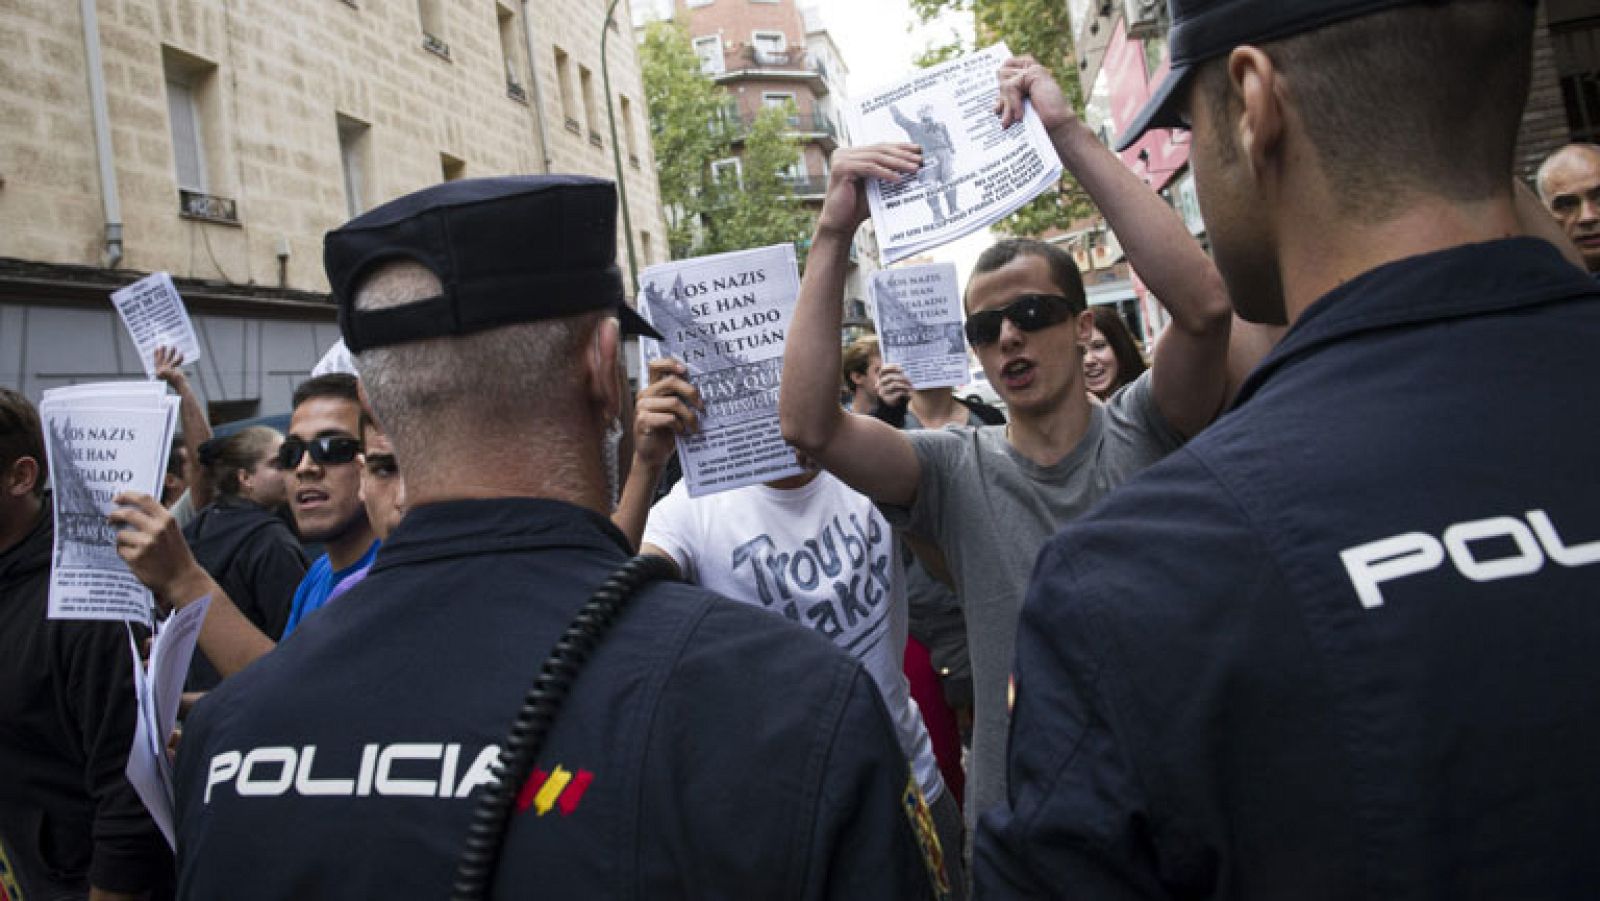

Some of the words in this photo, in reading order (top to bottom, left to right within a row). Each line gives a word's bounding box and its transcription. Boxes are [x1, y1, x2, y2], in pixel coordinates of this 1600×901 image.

[674, 280, 708, 300] LOS
[712, 268, 766, 292] NAZIS
[691, 302, 711, 318] SE
[716, 292, 755, 313] HAN
[677, 308, 780, 342] INSTALADO
[713, 328, 784, 356] TETUÁN
[699, 378, 736, 400] HAY
[86, 427, 135, 441] NAZIS
[86, 448, 118, 461] HAN
[1339, 508, 1600, 609] POL
